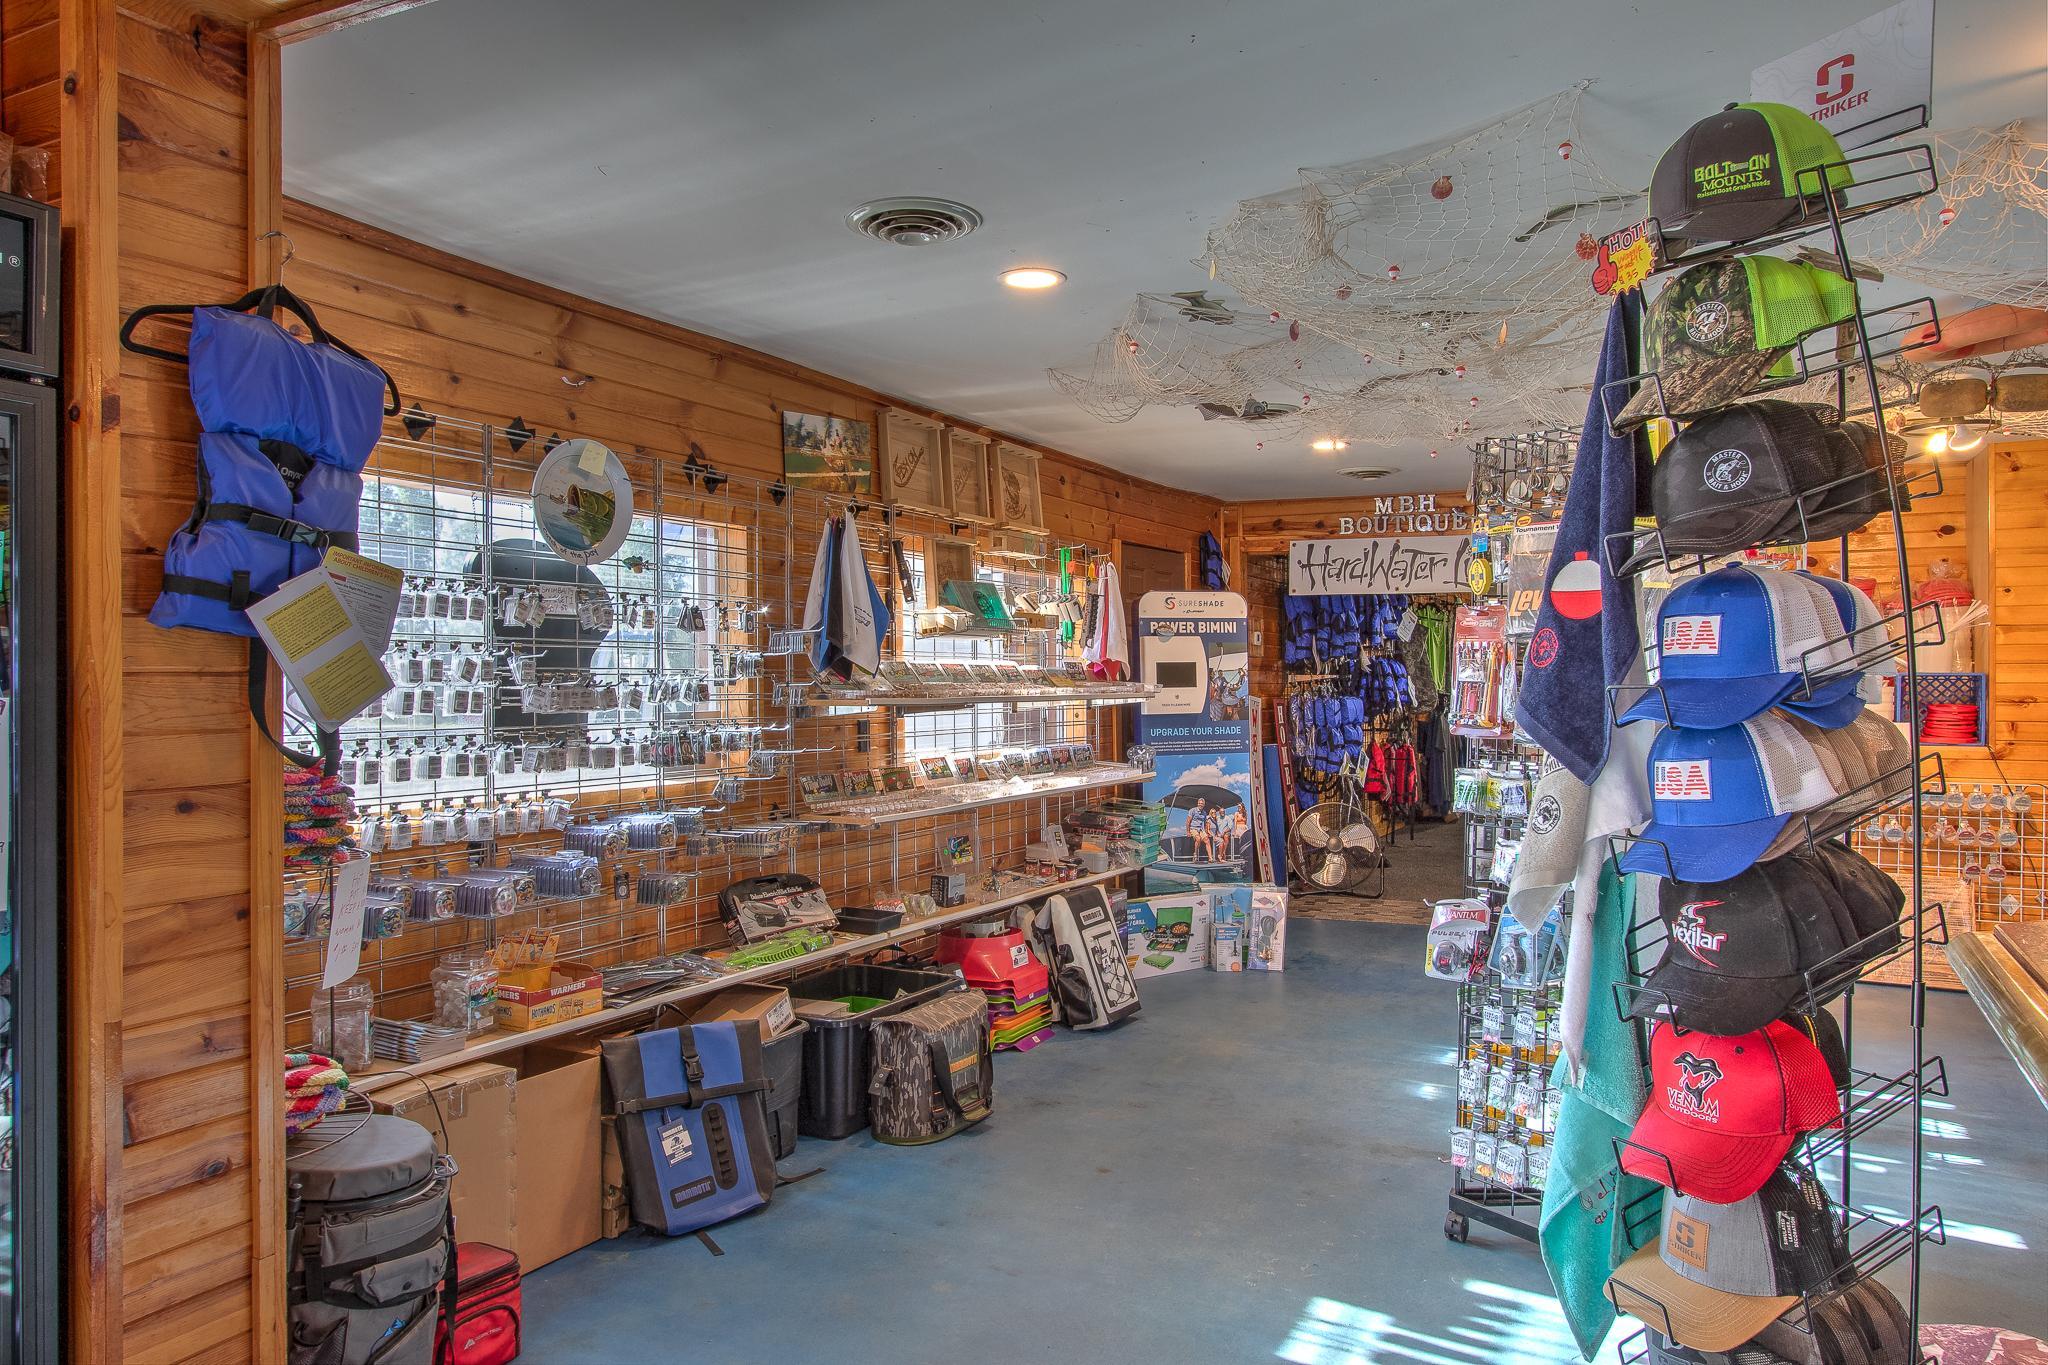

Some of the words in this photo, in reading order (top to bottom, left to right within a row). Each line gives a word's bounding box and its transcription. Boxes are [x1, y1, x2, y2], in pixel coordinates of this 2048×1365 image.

[1809, 91, 1869, 121] TRIKER
[1695, 162, 1731, 183] BOLT
[1749, 153, 1770, 171] ON
[1702, 171, 1763, 192] MOUNTS
[1697, 190, 1717, 199] Raised
[1718, 186, 1732, 194] Boat
[1608, 219, 1649, 255] HOT!
[1695, 303, 1723, 313] MASTER
[1707, 324, 1725, 338] HOOK
[1712, 452, 1742, 463] MASTER
[1708, 478, 1723, 490] BAIT
[1730, 472, 1749, 489] HOOK
[1339, 513, 1468, 535] BOUTIQUE
[1515, 525, 1557, 534] Tournament
[333, 550, 363, 565] IMPORTANT
[333, 557, 351, 568] ABOUT
[1198, 621, 1237, 634] BIMINI
[1664, 621, 1718, 650] USA
[1150, 728, 1190, 737] UPGRADE
[1191, 727, 1212, 735] YOUR
[1214, 726, 1241, 734] SHADE
[1277, 705, 1292, 786] HOME
[1655, 765, 1710, 795] USA
[1251, 708, 1271, 882] WELCOME
[550, 980, 586, 996] WARMERS
[1669, 1103, 1718, 1124] OUTDOORS
